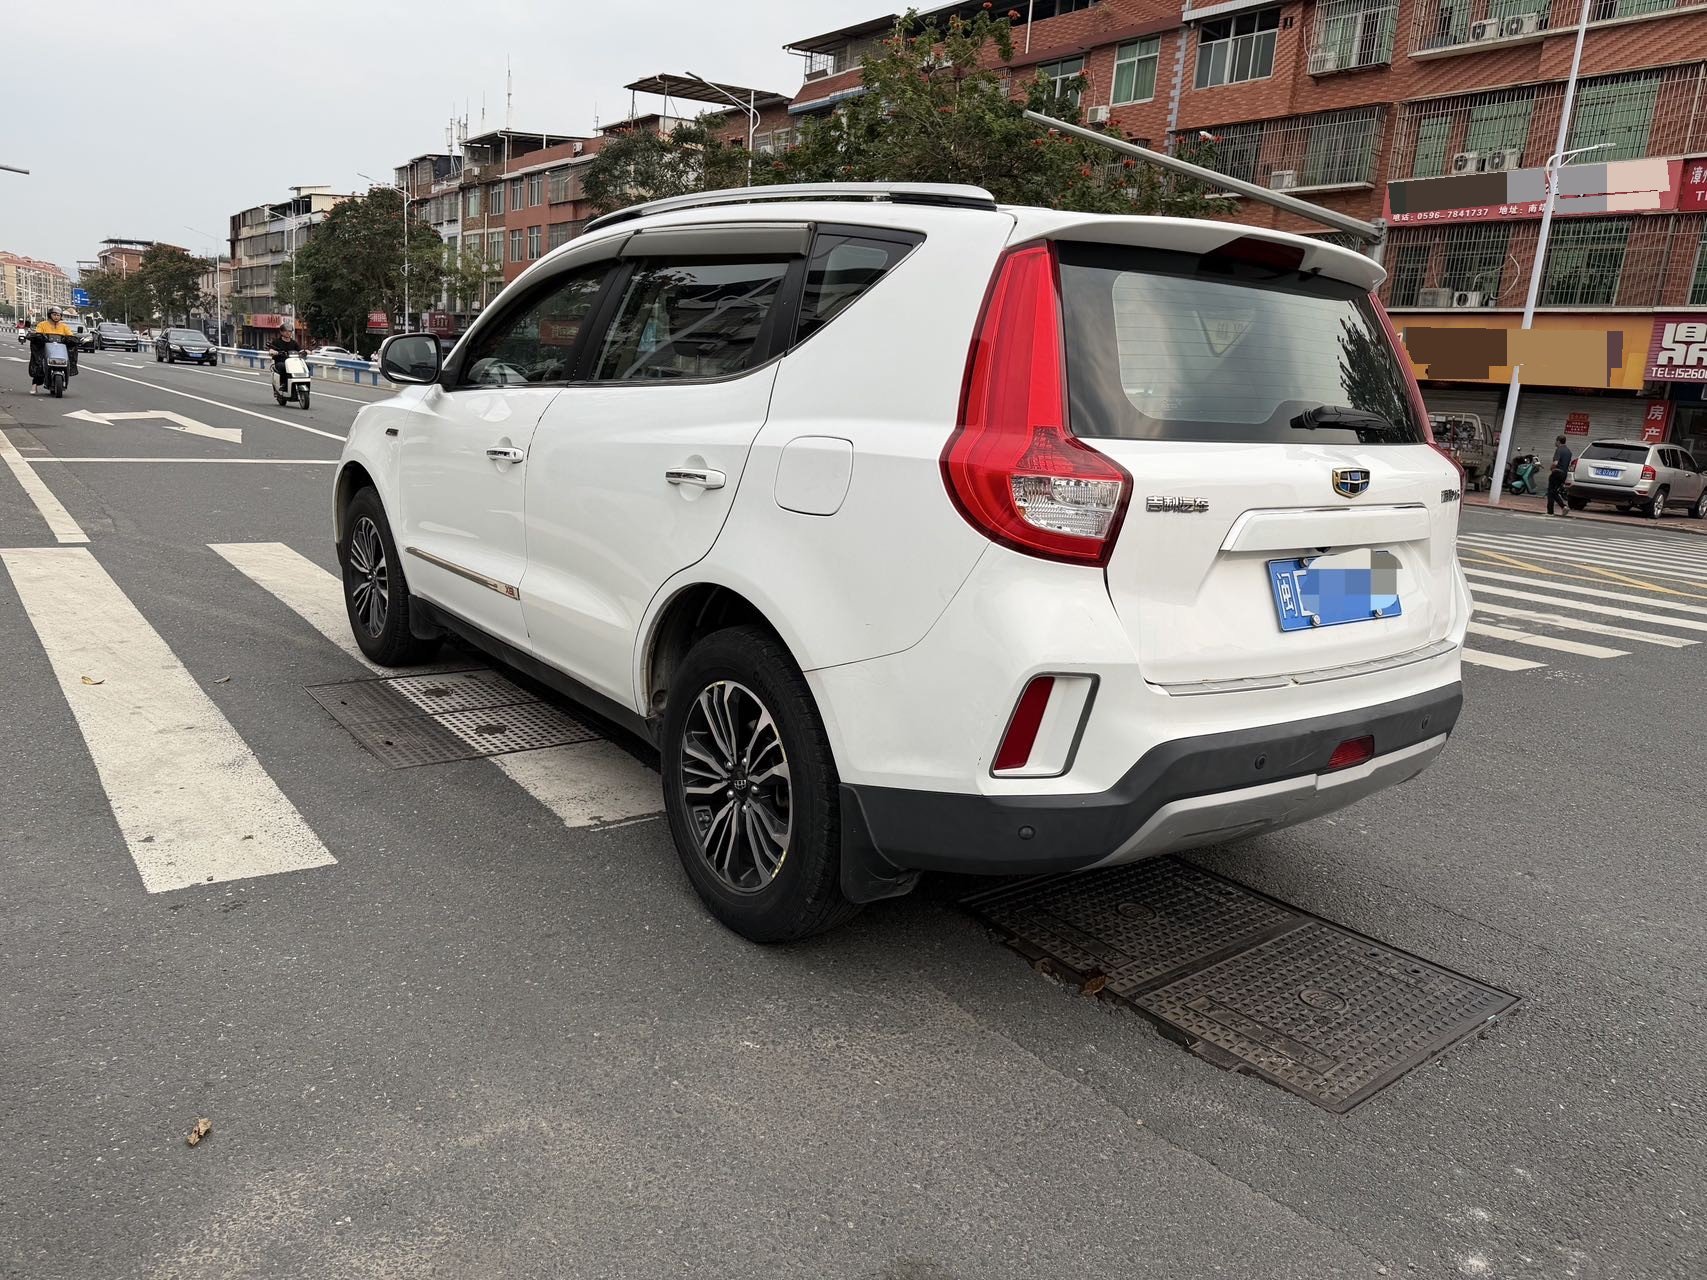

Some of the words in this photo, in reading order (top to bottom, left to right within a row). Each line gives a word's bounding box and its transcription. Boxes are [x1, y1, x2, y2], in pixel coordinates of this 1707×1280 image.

[1651, 367, 1707, 379] TEL:15260
[1642, 405, 1664, 441] 房产
[1146, 495, 1210, 513] 吉利汽车
